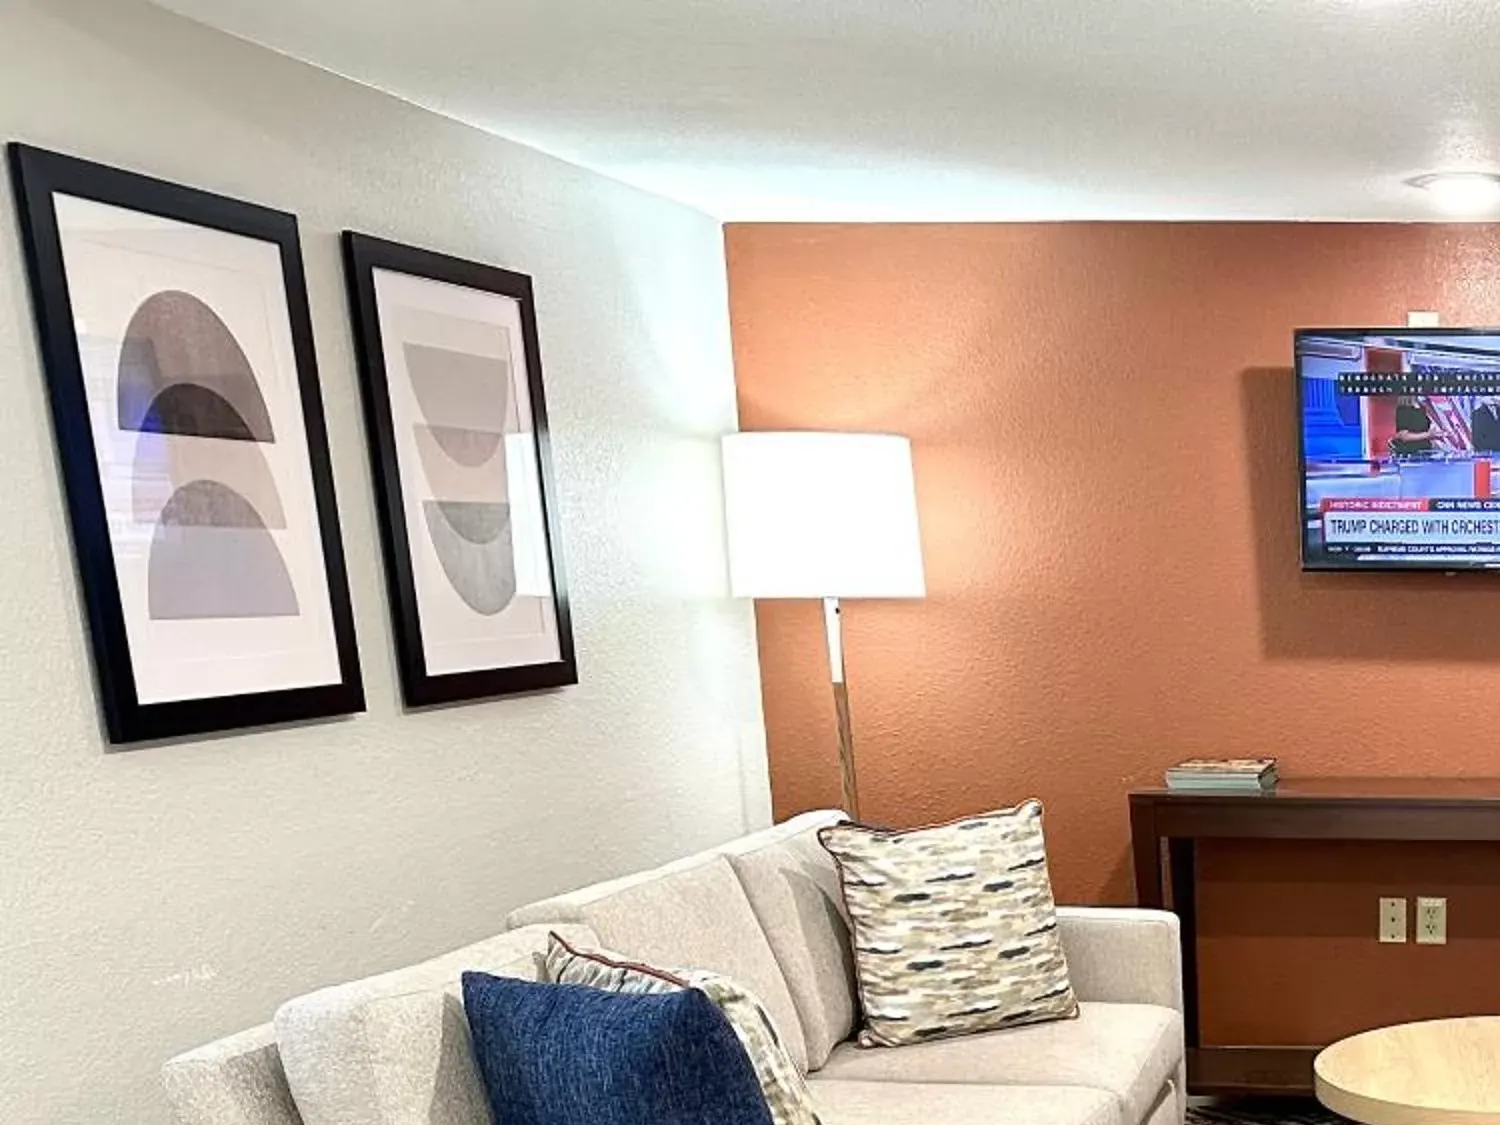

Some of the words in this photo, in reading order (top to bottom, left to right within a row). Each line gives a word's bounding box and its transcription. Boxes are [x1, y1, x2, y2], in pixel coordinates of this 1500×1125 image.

[1436, 501, 1455, 509] CNN
[1456, 501, 1482, 509] NEWS
[1330, 519, 1367, 535] TRUMP
[1369, 519, 1419, 535] CHARGED
[1423, 519, 1449, 535] WITH
